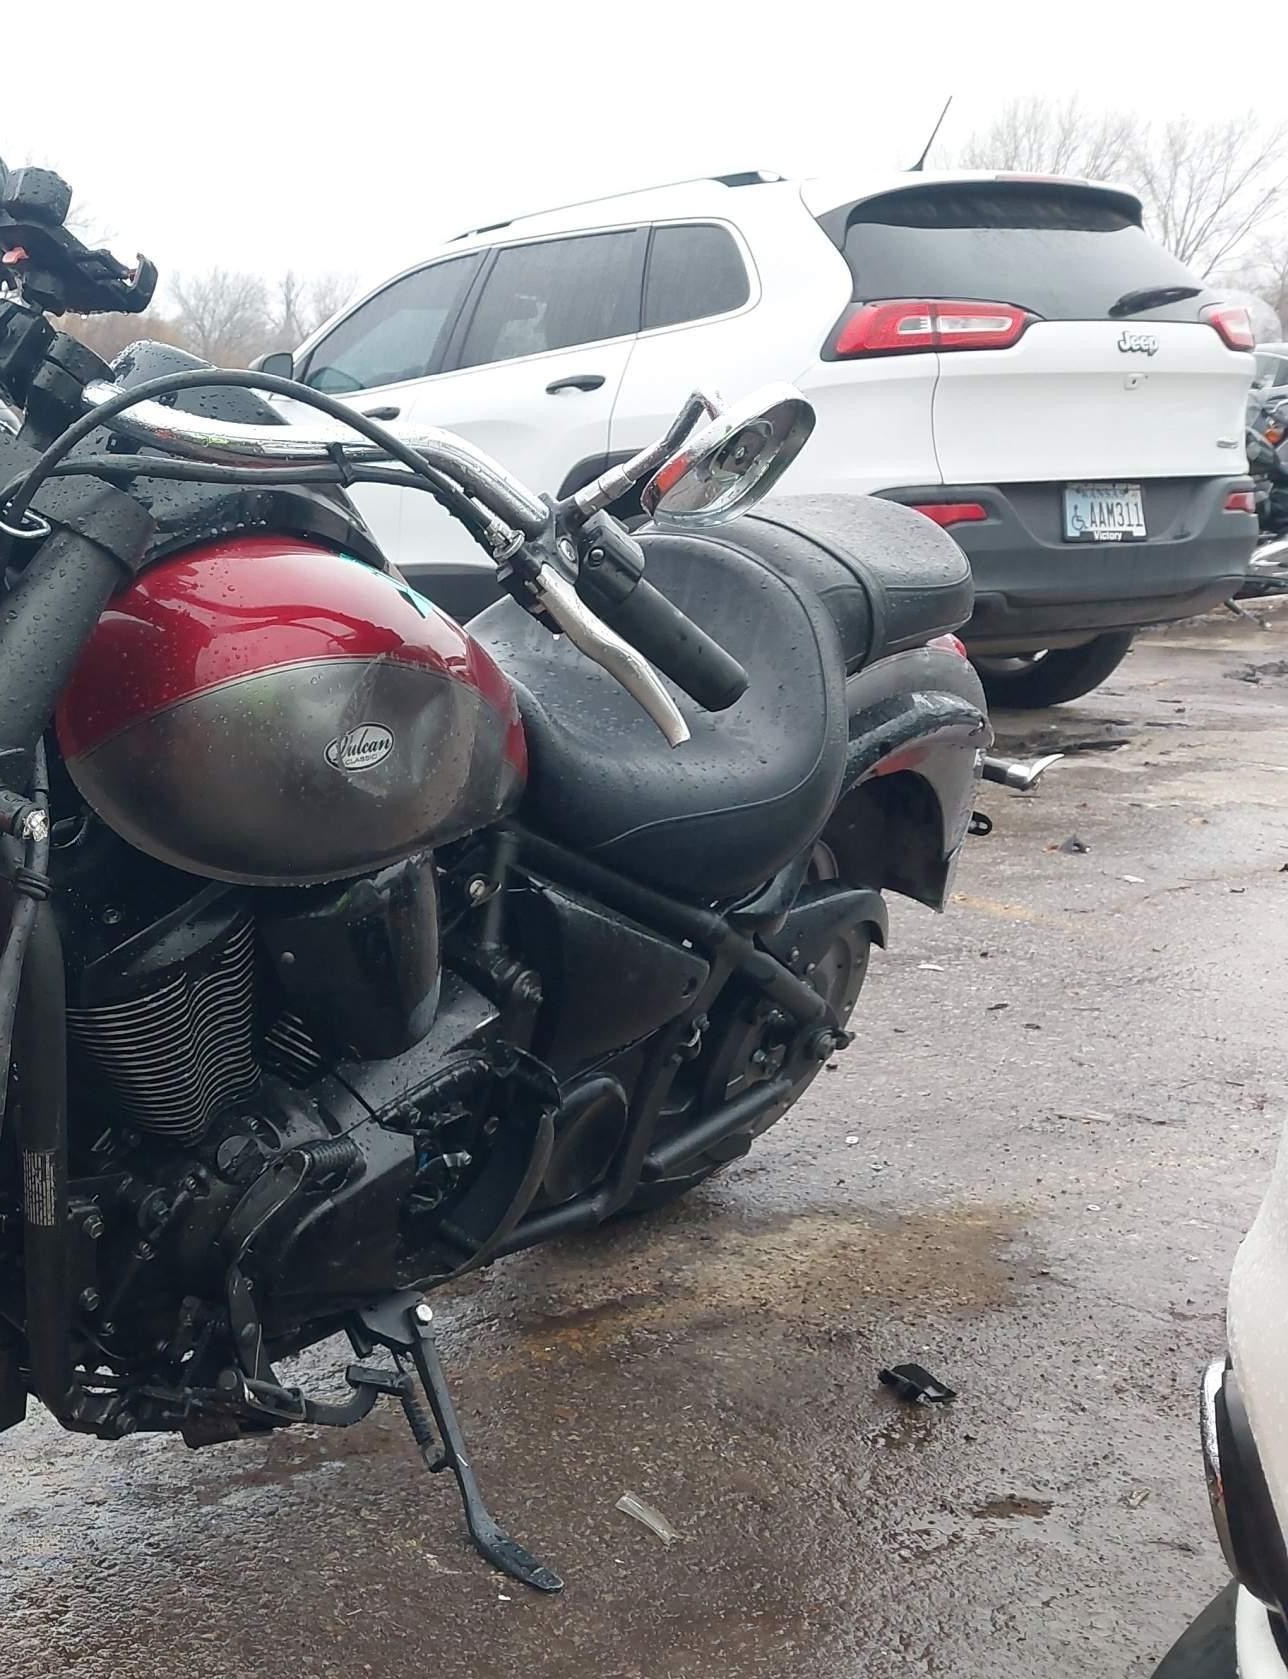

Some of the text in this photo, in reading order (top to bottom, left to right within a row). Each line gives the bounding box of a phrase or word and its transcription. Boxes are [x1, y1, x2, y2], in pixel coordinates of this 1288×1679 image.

[1118, 331, 1159, 356] Jeep
[336, 728, 391, 759] Vulcan
[345, 753, 378, 766] CLASSIC
